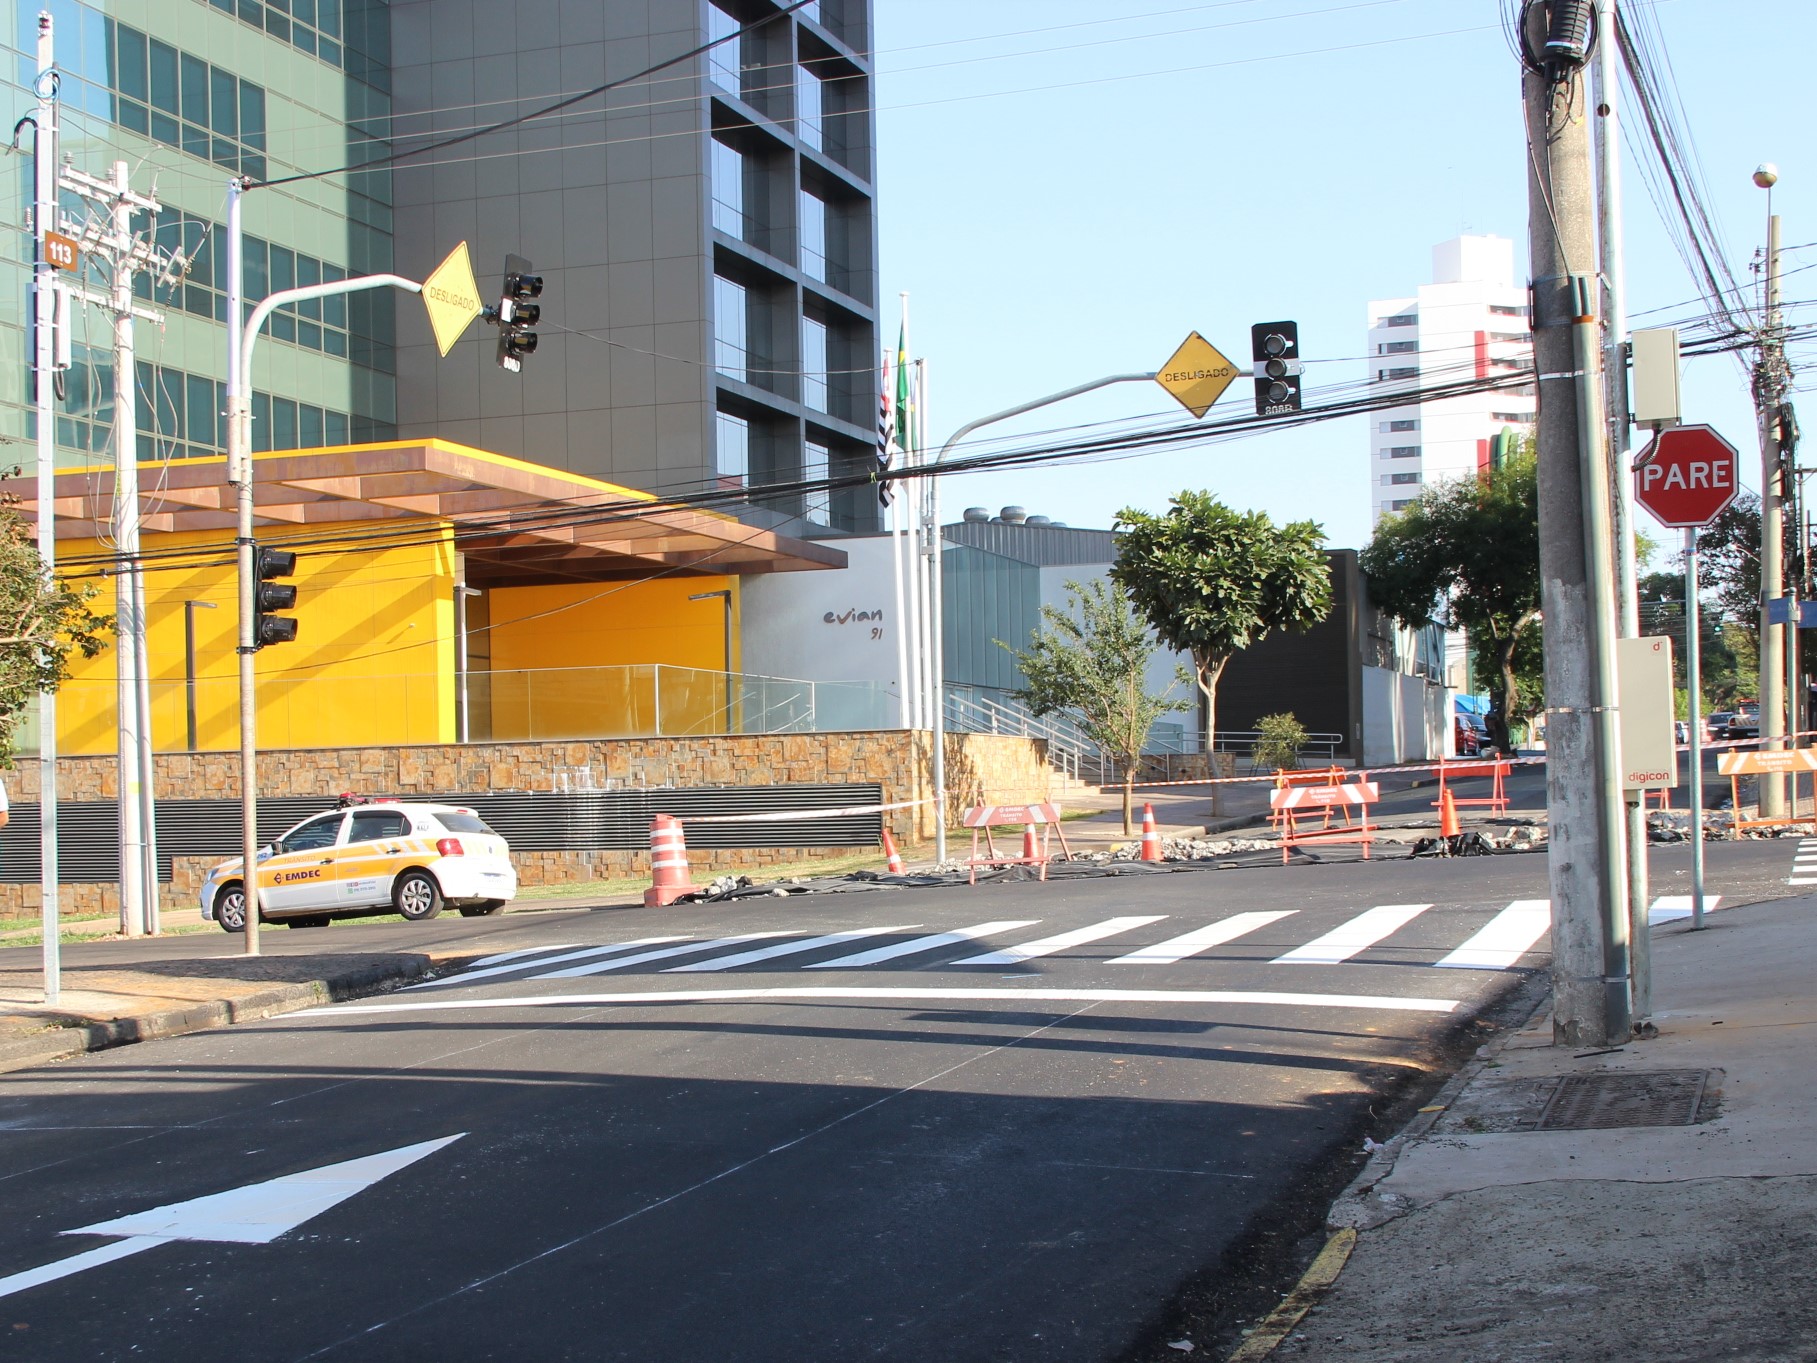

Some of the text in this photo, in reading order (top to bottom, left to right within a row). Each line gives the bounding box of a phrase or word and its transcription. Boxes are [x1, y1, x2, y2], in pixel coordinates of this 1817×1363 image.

[50, 241, 72, 265] 113
[430, 286, 475, 311] DESLIGADO
[1165, 367, 1230, 382] DESLIGADO
[1643, 459, 1730, 492] PARE
[823, 607, 883, 625] evian
[871, 627, 883, 641] 91
[1628, 771, 1669, 784] digicon
[285, 869, 321, 881] EMDEC
